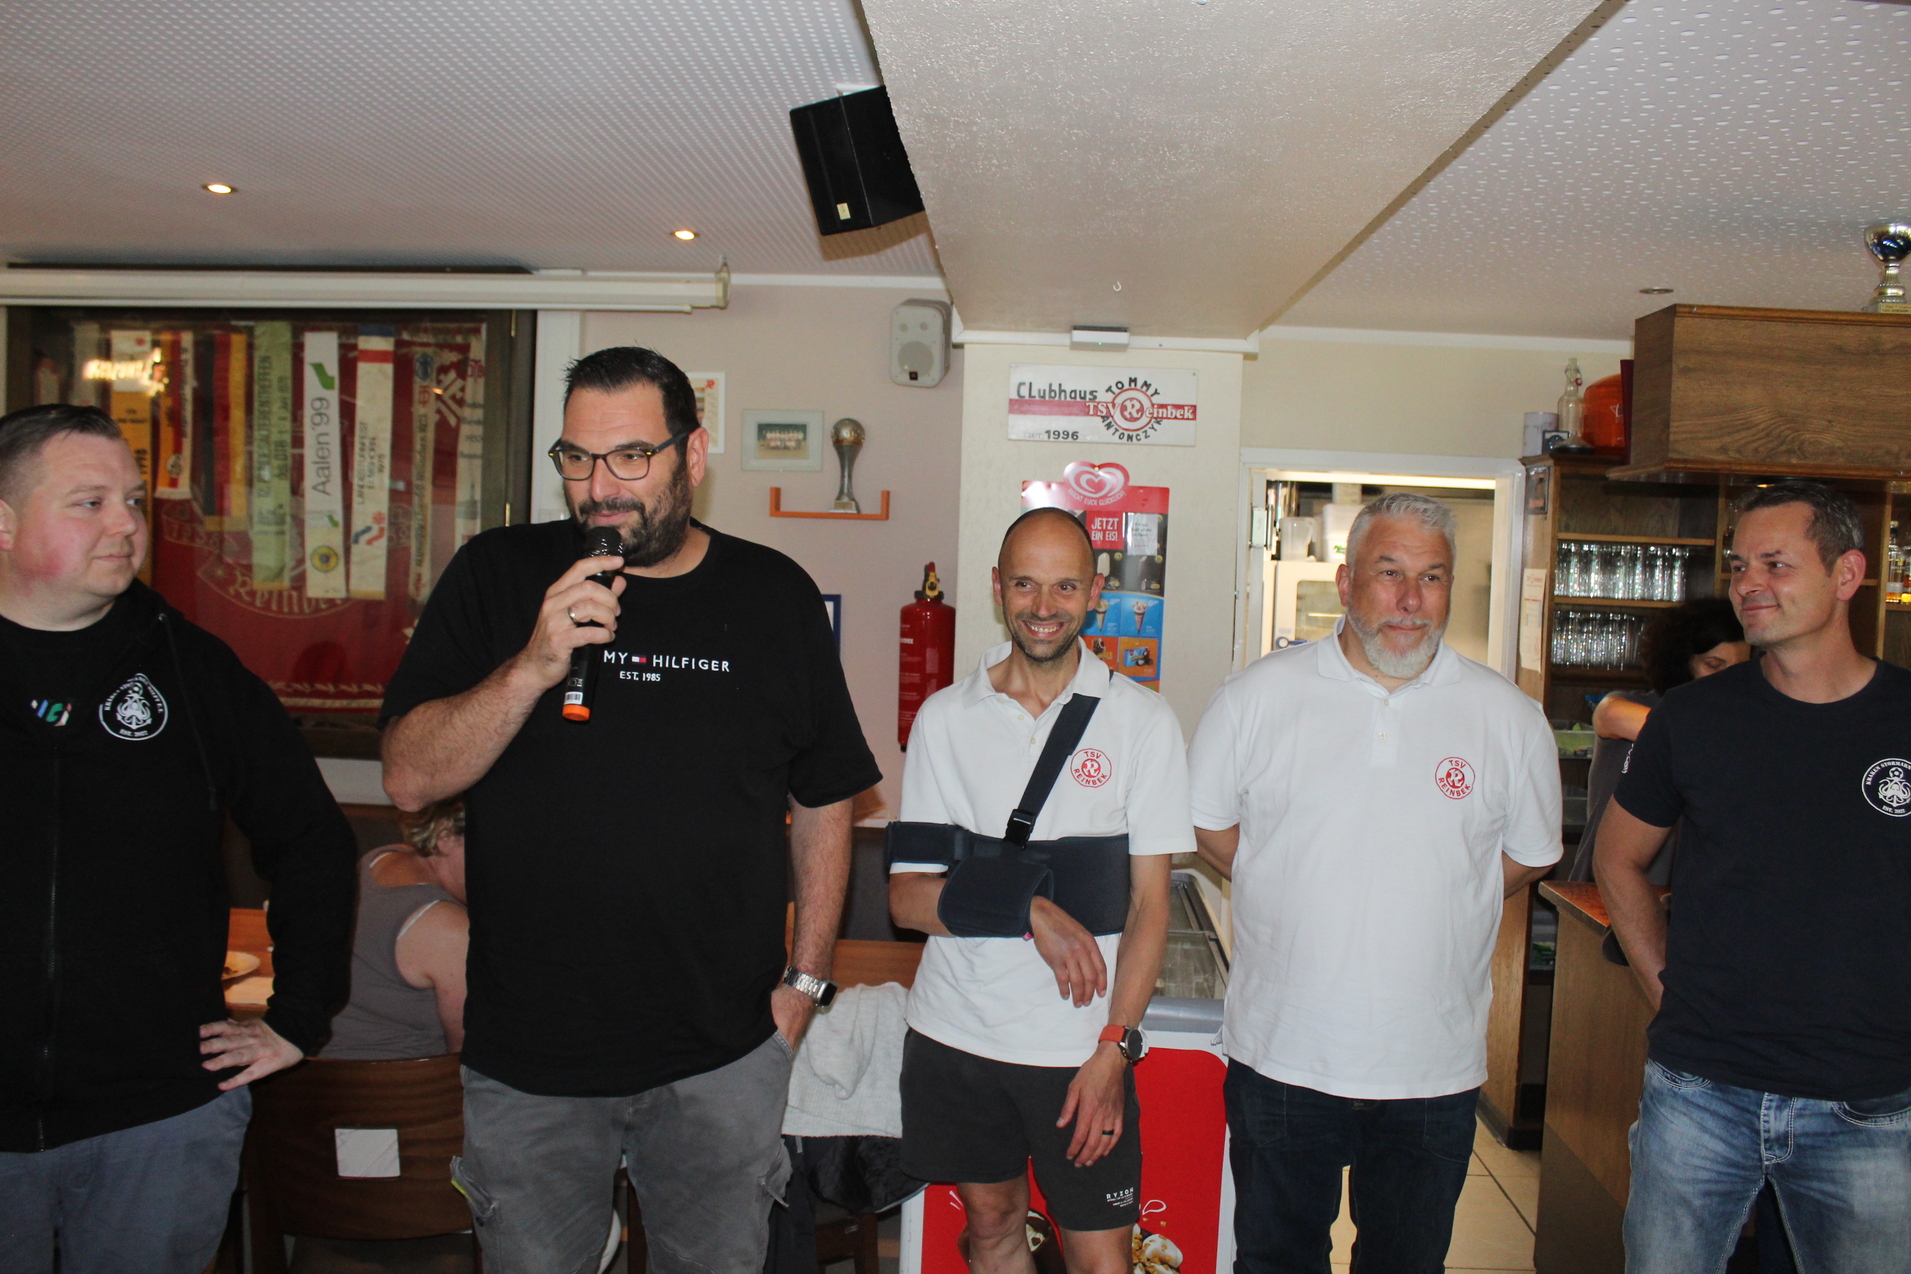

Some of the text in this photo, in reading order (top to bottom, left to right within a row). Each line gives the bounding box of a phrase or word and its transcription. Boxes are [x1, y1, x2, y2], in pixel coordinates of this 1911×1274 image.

[1105, 377, 1160, 398] TOMMY
[1086, 402, 1121, 416] TSV
[1044, 430, 1080, 441] 1996
[1101, 415, 1163, 442] ANTONCZYK
[1091, 518, 1119, 530] JETZT
[652, 654, 730, 672] HILFIGER
[619, 671, 661, 682] EST. 1985
[1084, 751, 1102, 759] TSV
[1448, 760, 1466, 769] TSV
[1073, 768, 1108, 785] REINBEK
[1438, 777, 1471, 797] REINBEK
